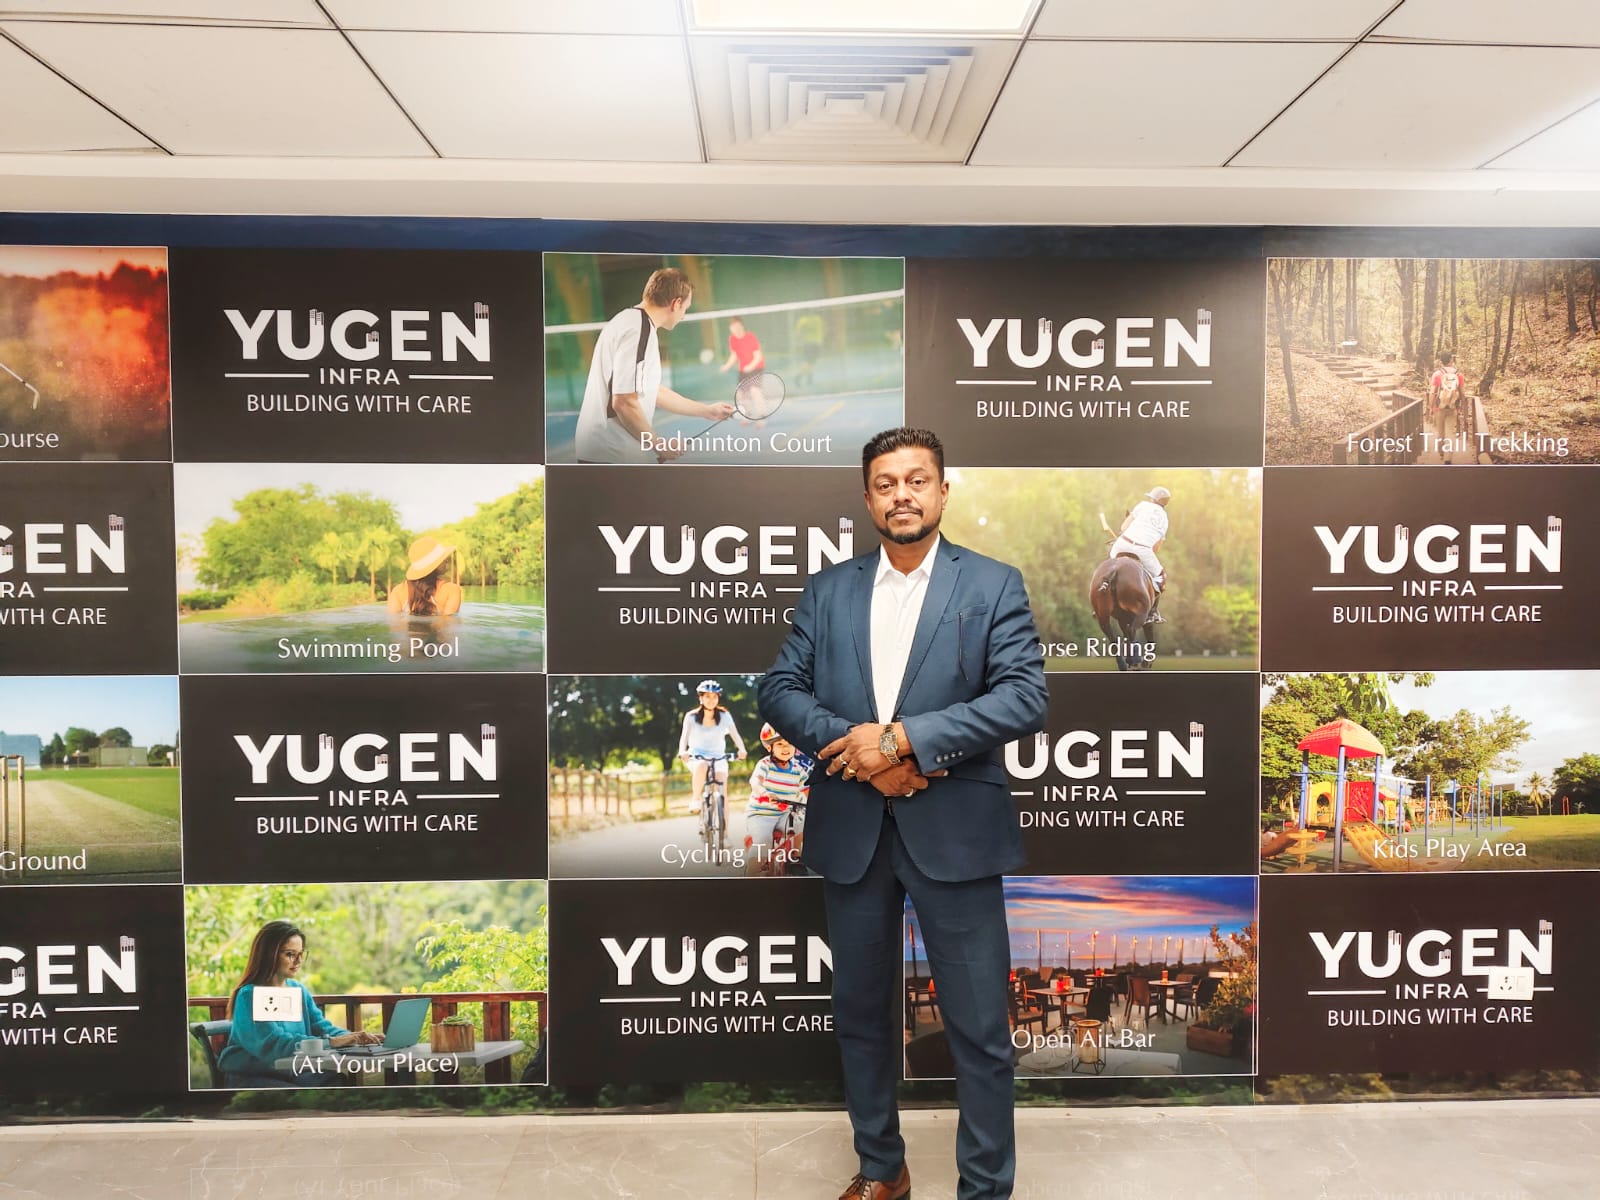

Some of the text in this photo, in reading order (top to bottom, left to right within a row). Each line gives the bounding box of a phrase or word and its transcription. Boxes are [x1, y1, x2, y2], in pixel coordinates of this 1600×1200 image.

[224, 302, 491, 363] YUGEN
[956, 308, 1212, 369] YUGEN
[319, 367, 400, 386] INFRA
[1046, 375, 1123, 392] INFRA
[247, 394, 472, 414] BUILDING WITH CARE
[976, 400, 1191, 419] BUILDING WITH CARE
[0, 432, 59, 448] ourse
[640, 430, 832, 453] Badminton Court
[1348, 431, 1569, 456] Forest Trail Trekking
[598, 517, 853, 575] YUGEN
[1313, 515, 1562, 575] YUGEN
[690, 581, 768, 598] INFRA
[1402, 580, 1477, 597] INFRA
[52, 607, 107, 625] CARE
[619, 607, 718, 625] BUILDING
[723, 607, 775, 625] WITH
[1332, 605, 1542, 624] BUILDING WITH CARE
[278, 637, 459, 663] Swimming Pool
[1038, 637, 1157, 661] orse Riding
[233, 724, 497, 785] YUGEN
[1004, 721, 1204, 780] UGEN
[329, 789, 408, 807] INFRA
[1043, 785, 1119, 801] INFRA
[256, 814, 478, 835] BUILDING WITH CARE
[1019, 810, 1185, 828] DING WITH CARE
[0, 848, 87, 871] Ground
[661, 843, 800, 868] Cycling Trac
[1374, 838, 1527, 862] Kids Play Area
[1309, 920, 1553, 980] YUGEN
[0, 935, 136, 996] GEN
[691, 990, 767, 1008] INFRA
[1395, 982, 1469, 1000] INFRA
[0, 1002, 47, 1019] FRA
[1327, 1006, 1533, 1027] BUILDING WITH CARE
[621, 1015, 834, 1035] BUILDING WITH CARE
[1, 1026, 118, 1046] WITH CARE
[1011, 1029, 1156, 1053] Open Air Bar
[292, 1052, 459, 1076] (At Your Place)
